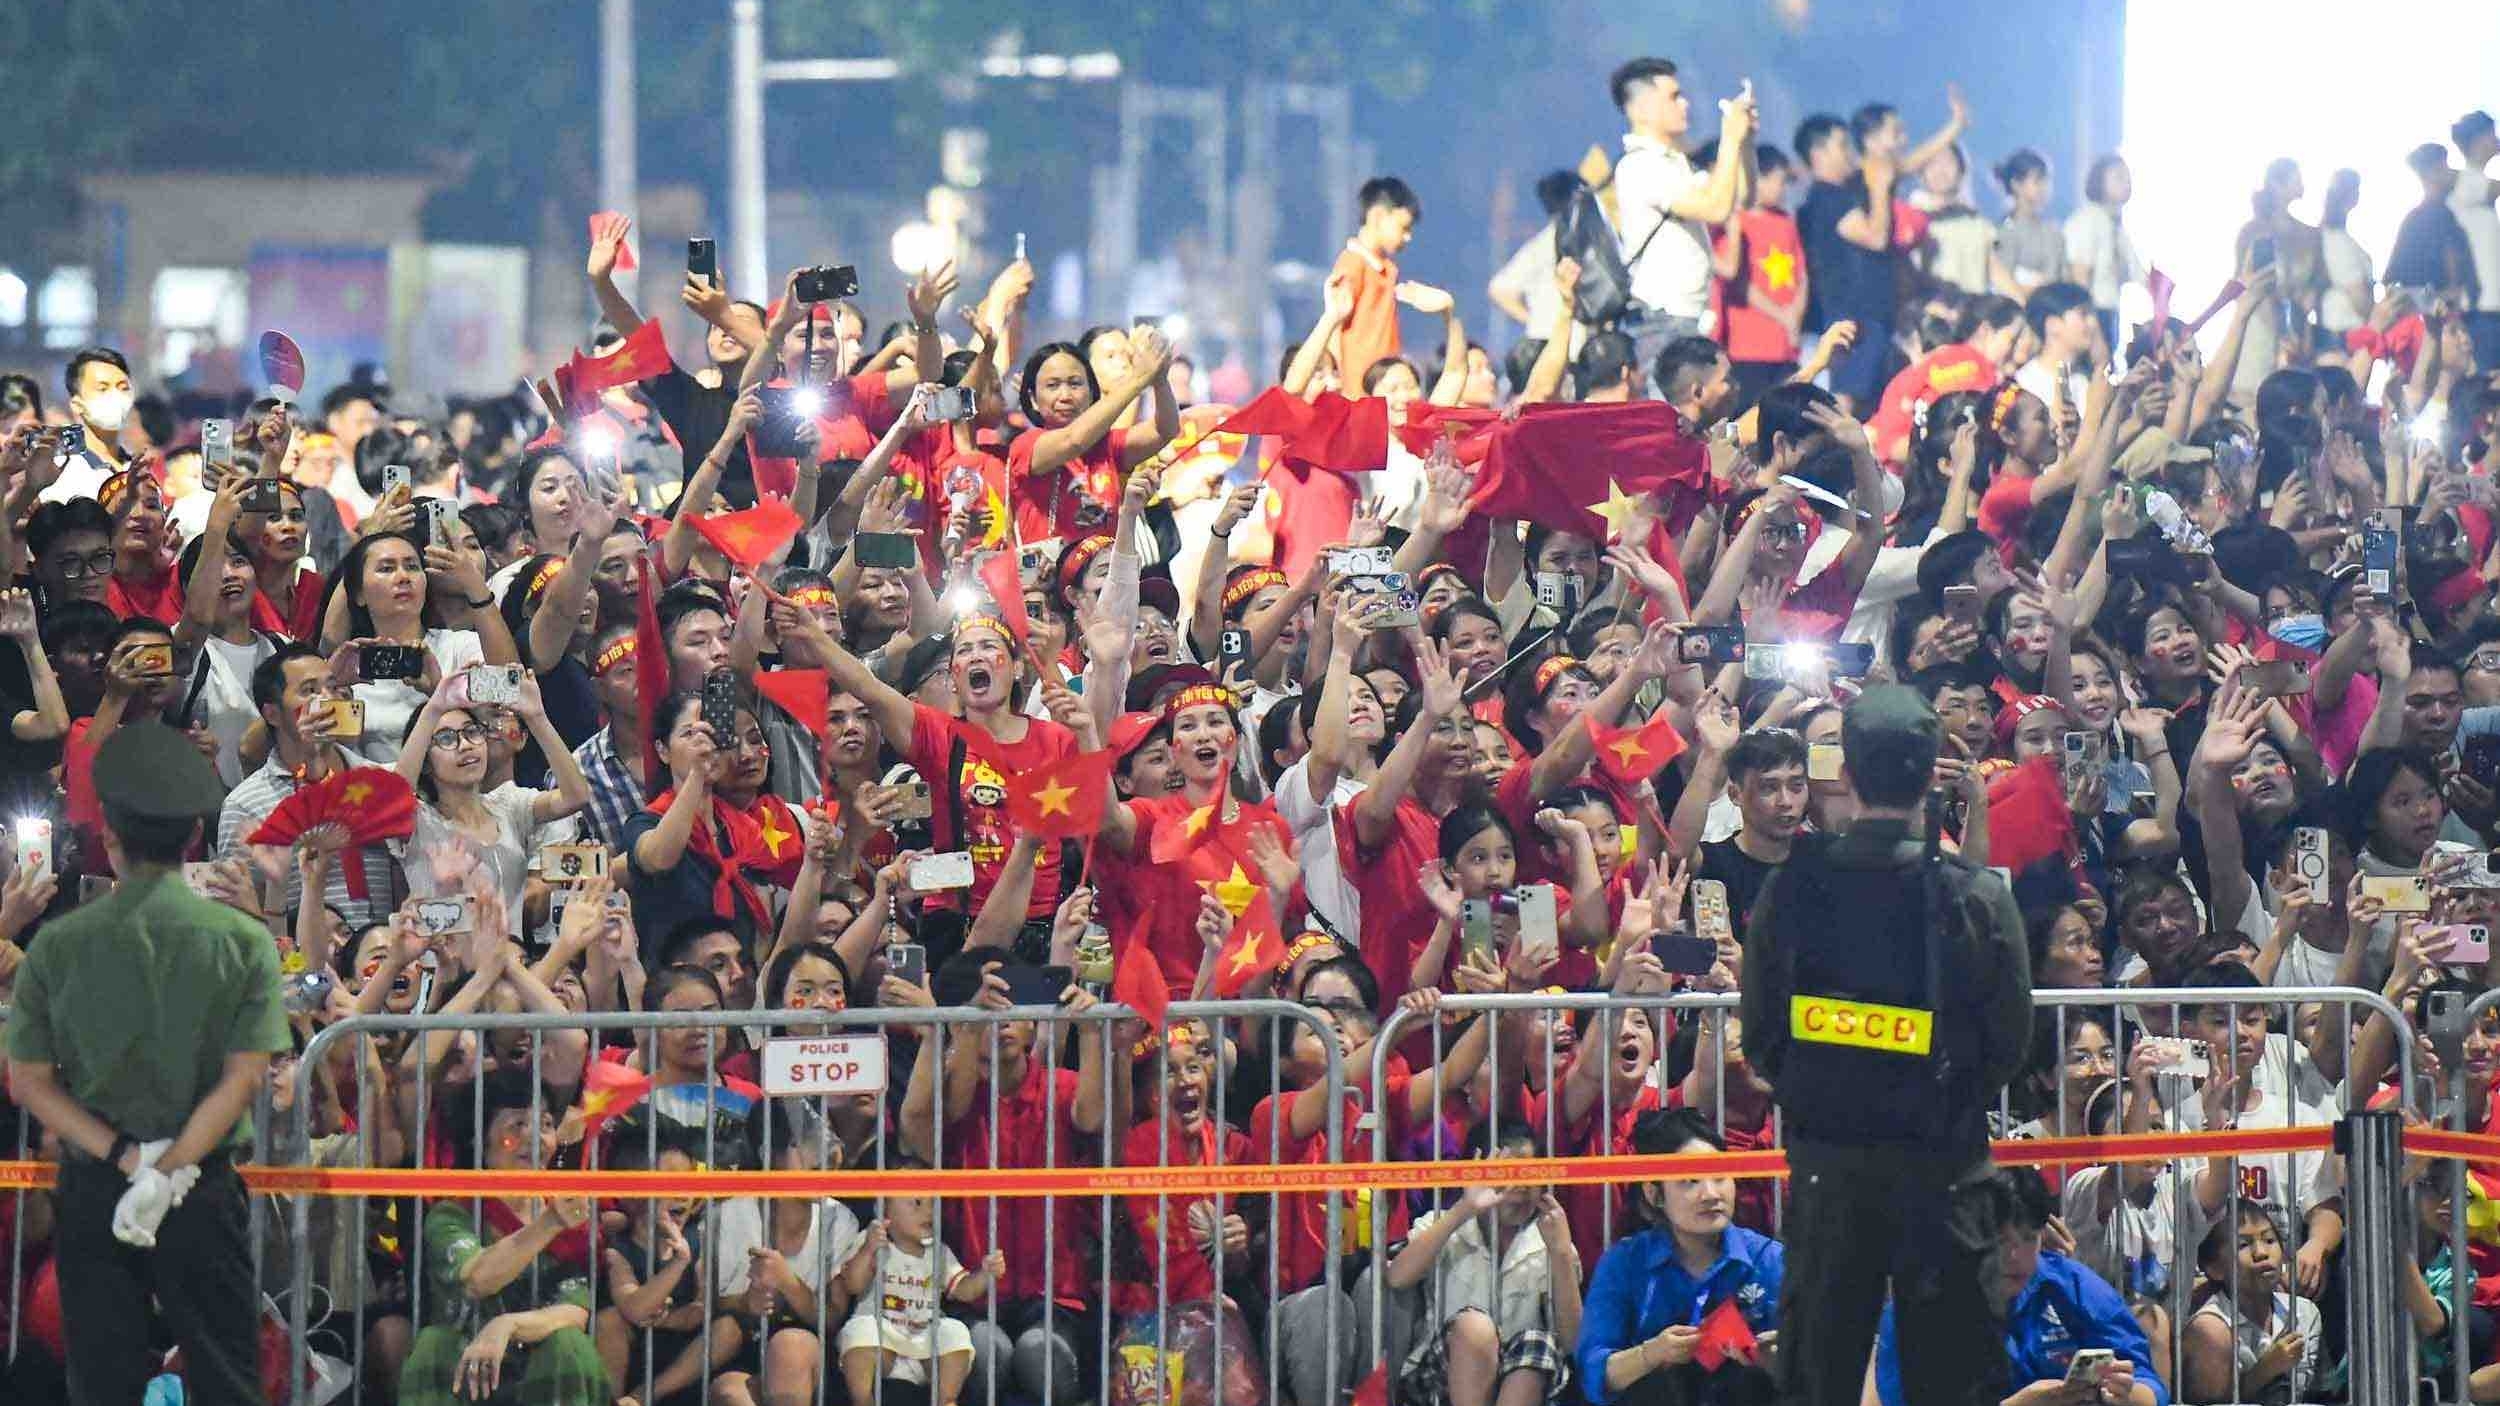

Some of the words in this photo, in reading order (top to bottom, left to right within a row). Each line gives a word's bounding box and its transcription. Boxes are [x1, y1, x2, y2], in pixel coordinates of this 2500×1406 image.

[800, 1043, 849, 1055] POLICE
[790, 1062, 859, 1082] STOP
[1518, 1166, 1569, 1178] CROSS
